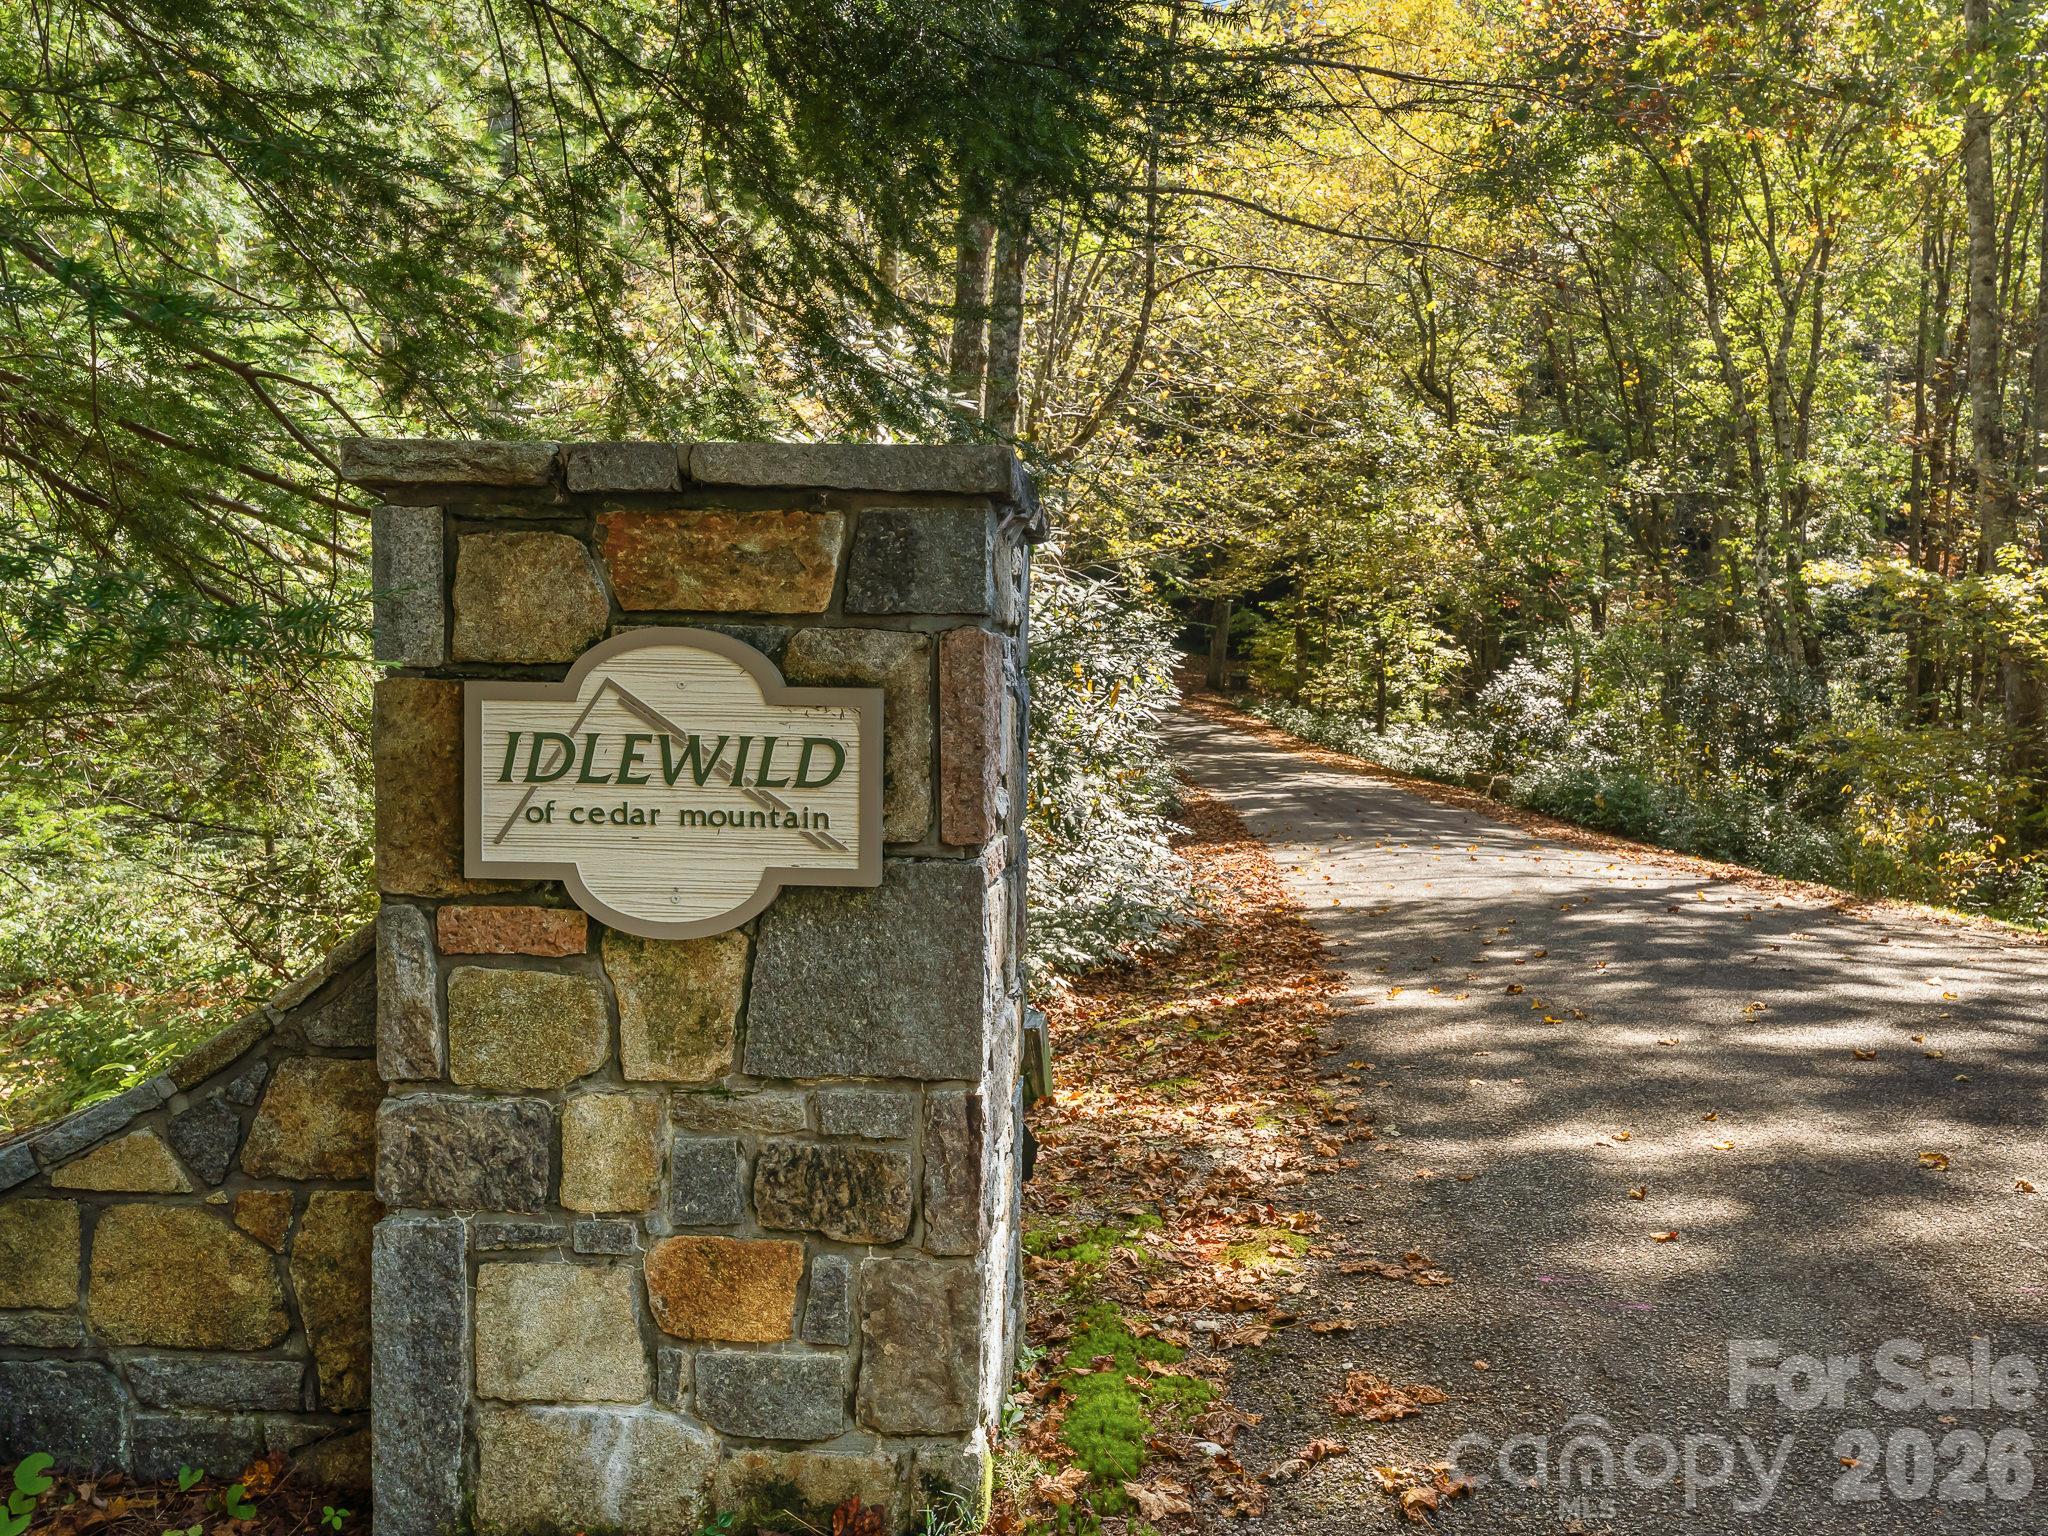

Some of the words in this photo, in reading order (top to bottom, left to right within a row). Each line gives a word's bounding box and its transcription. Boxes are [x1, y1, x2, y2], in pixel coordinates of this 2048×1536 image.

[497, 731, 847, 789] IDLEWILD
[525, 801, 556, 825] of
[569, 802, 660, 826] cedar
[679, 805, 830, 830] mountain
